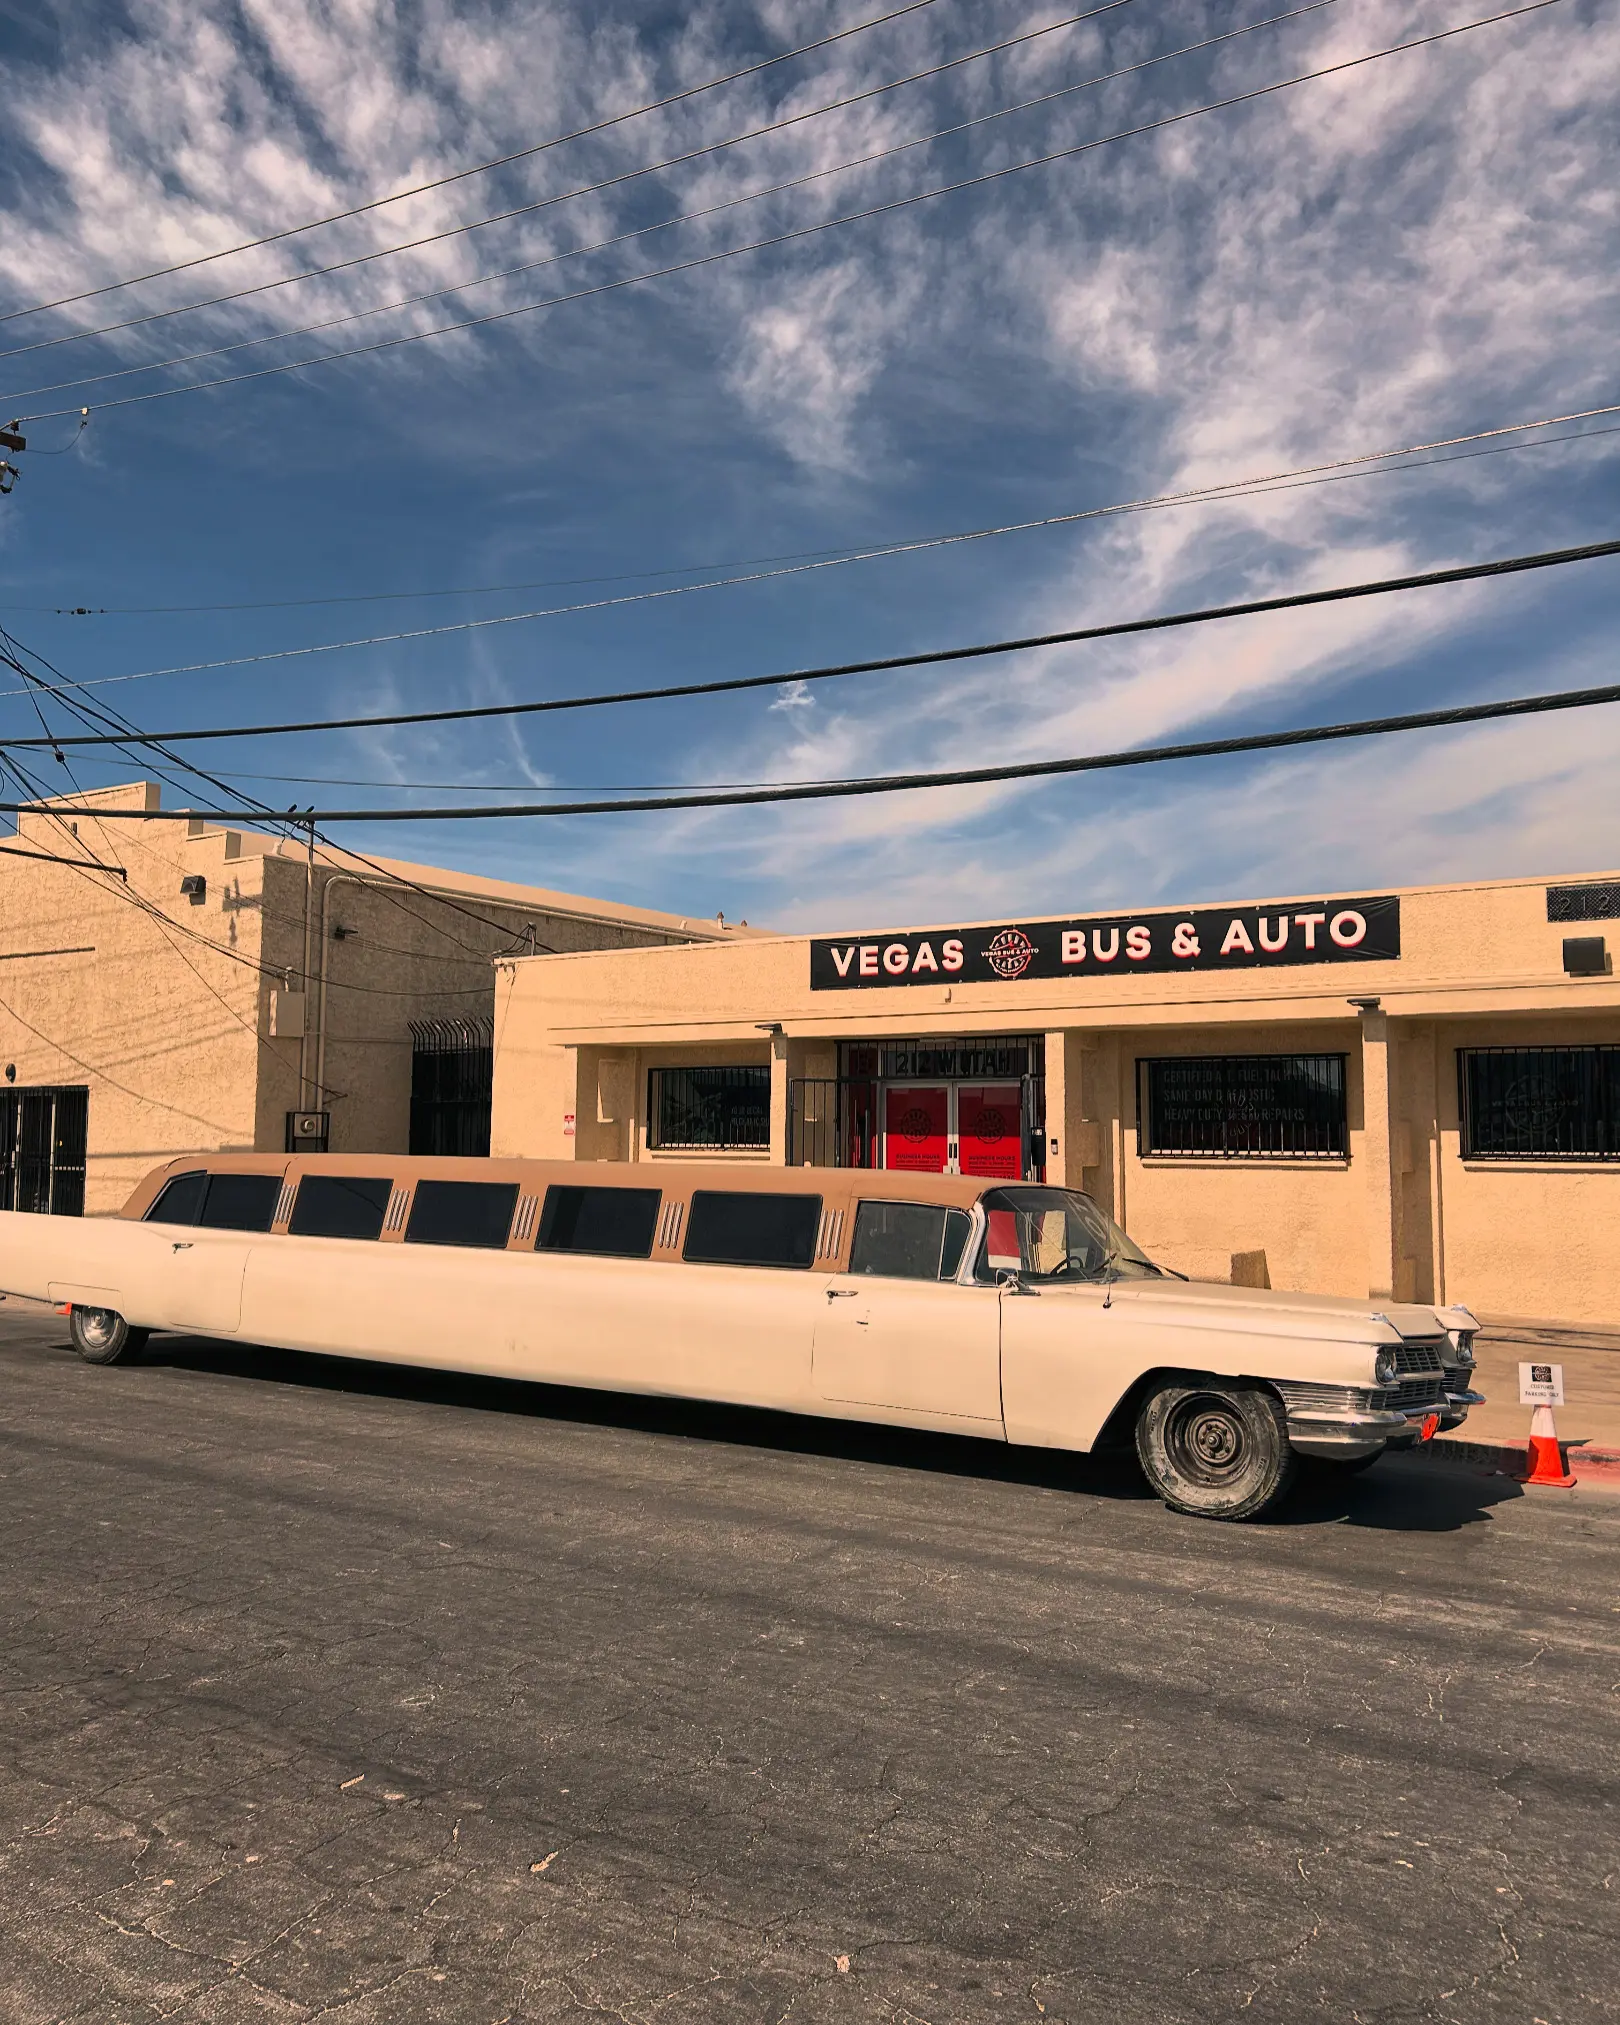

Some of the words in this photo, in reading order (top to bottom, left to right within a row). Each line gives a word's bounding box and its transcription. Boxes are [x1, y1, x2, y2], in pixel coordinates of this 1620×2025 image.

[1559, 894, 1610, 913] 212
[830, 939, 965, 977] VEGAS
[1061, 925, 1153, 964] BUS
[1171, 922, 1203, 959] &
[1219, 910, 1368, 957] AUTO
[896, 1053, 931, 1075] 212
[937, 1051, 956, 1074] W
[960, 1048, 1011, 1074] UTAH
[1262, 1107, 1305, 1121] REPAIRS
